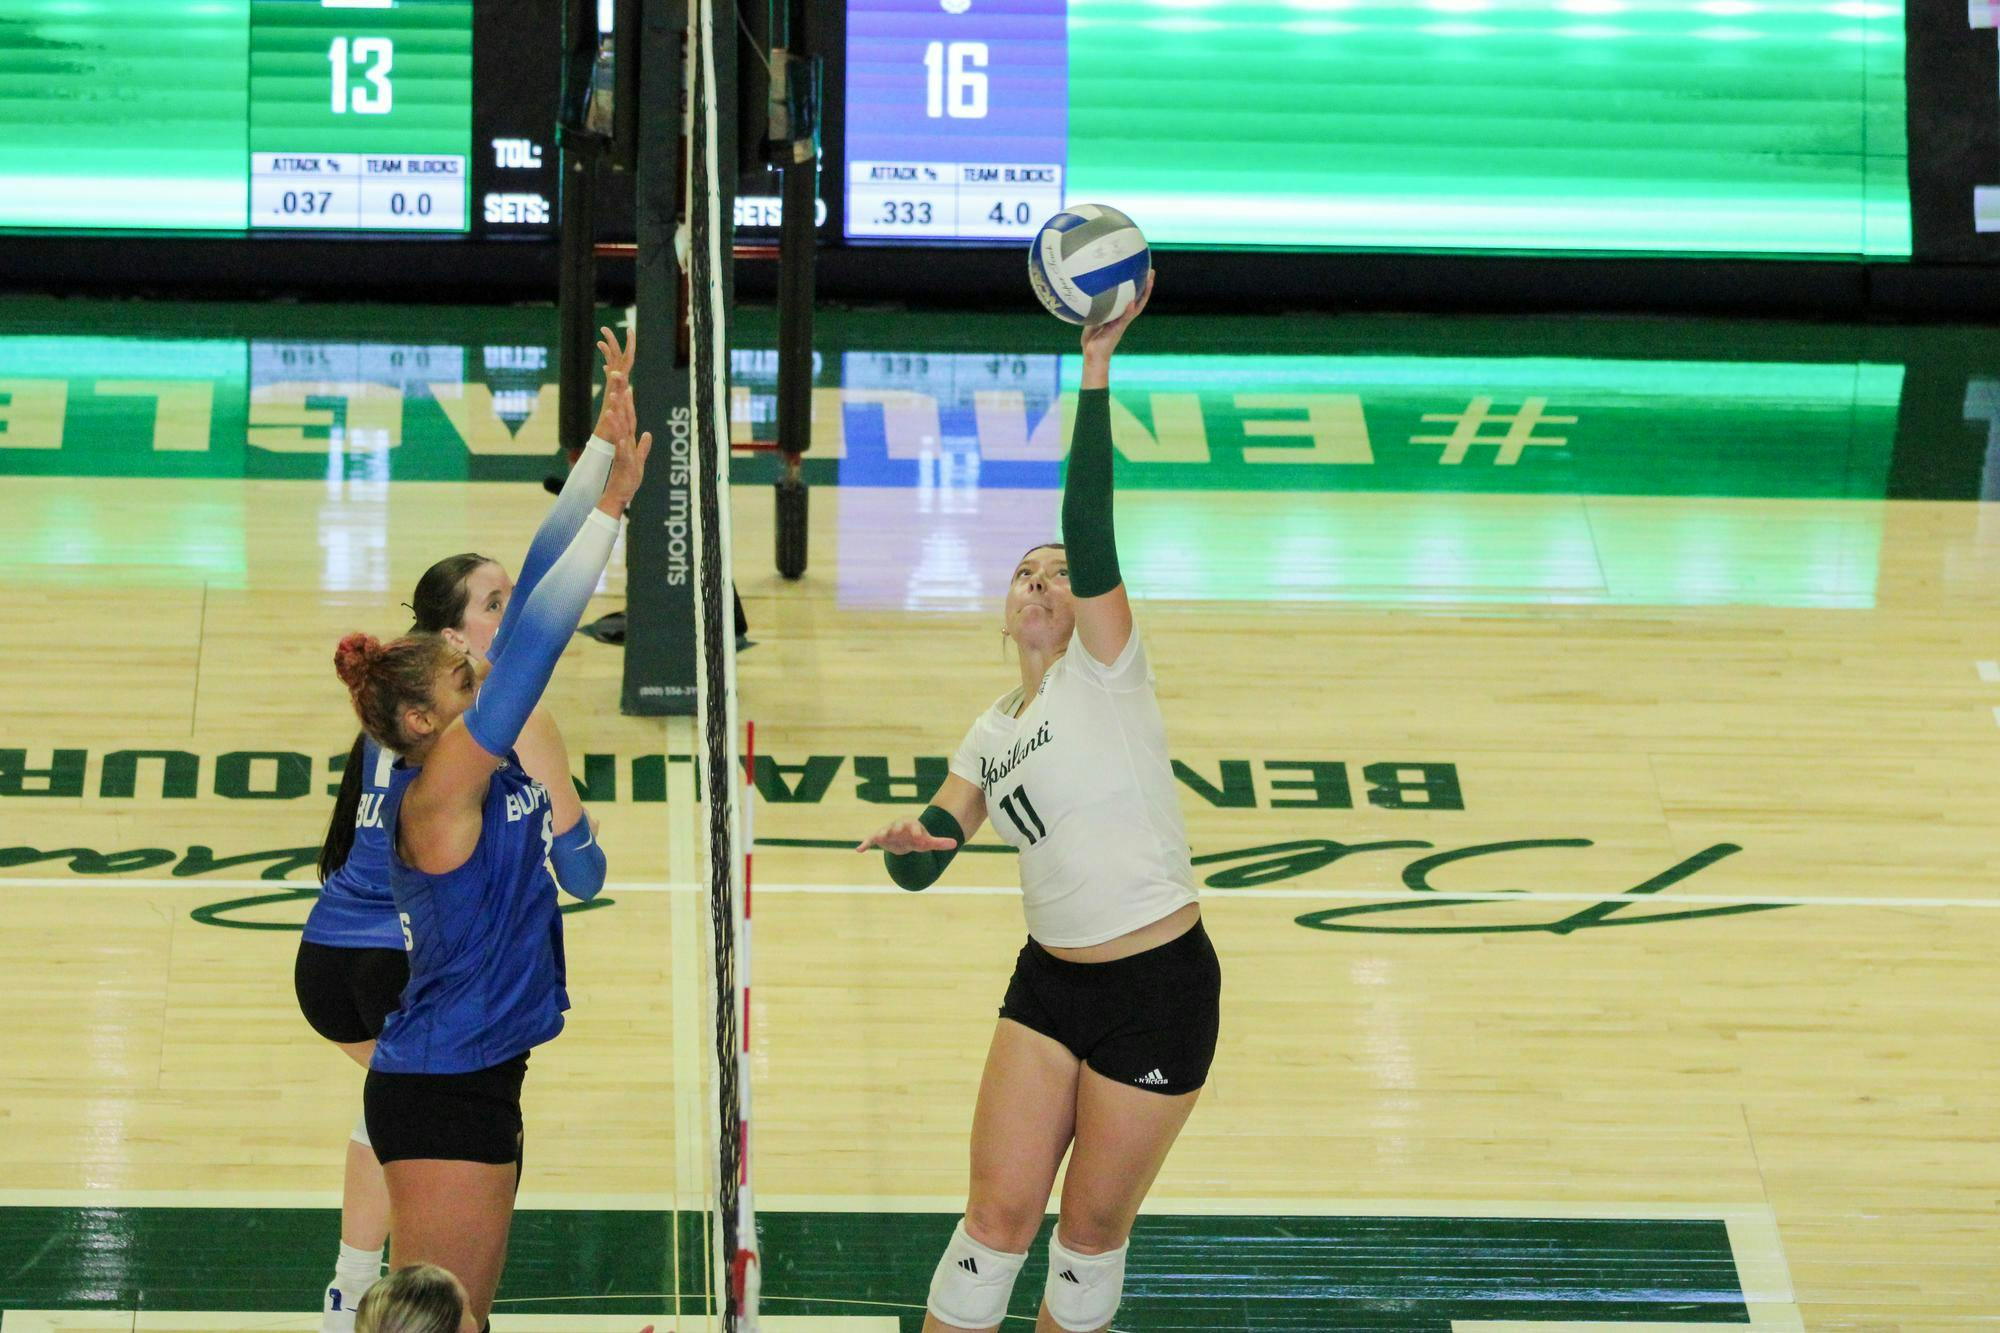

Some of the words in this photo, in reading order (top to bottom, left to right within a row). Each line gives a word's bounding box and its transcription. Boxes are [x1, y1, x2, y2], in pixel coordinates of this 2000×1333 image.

[327, 36, 393, 114] 13
[923, 41, 989, 119] 16
[272, 158, 320, 171] ATTACK
[366, 159, 402, 173] TEAM
[407, 160, 458, 174] BLOCKS
[870, 166, 917, 180] ATTACK
[963, 168, 1000, 181] TEAM
[1004, 168, 1055, 183] BLOCKS
[272, 191, 333, 215] .037
[390, 193, 432, 216] 0.0
[483, 192, 550, 224] SETS:
[873, 201, 932, 225] .333
[988, 202, 1030, 225] 4.0
[666, 406, 691, 486] sports
[663, 489, 690, 586] imports
[979, 720, 1054, 798] Ypsilanti
[998, 784, 1047, 846] 11
